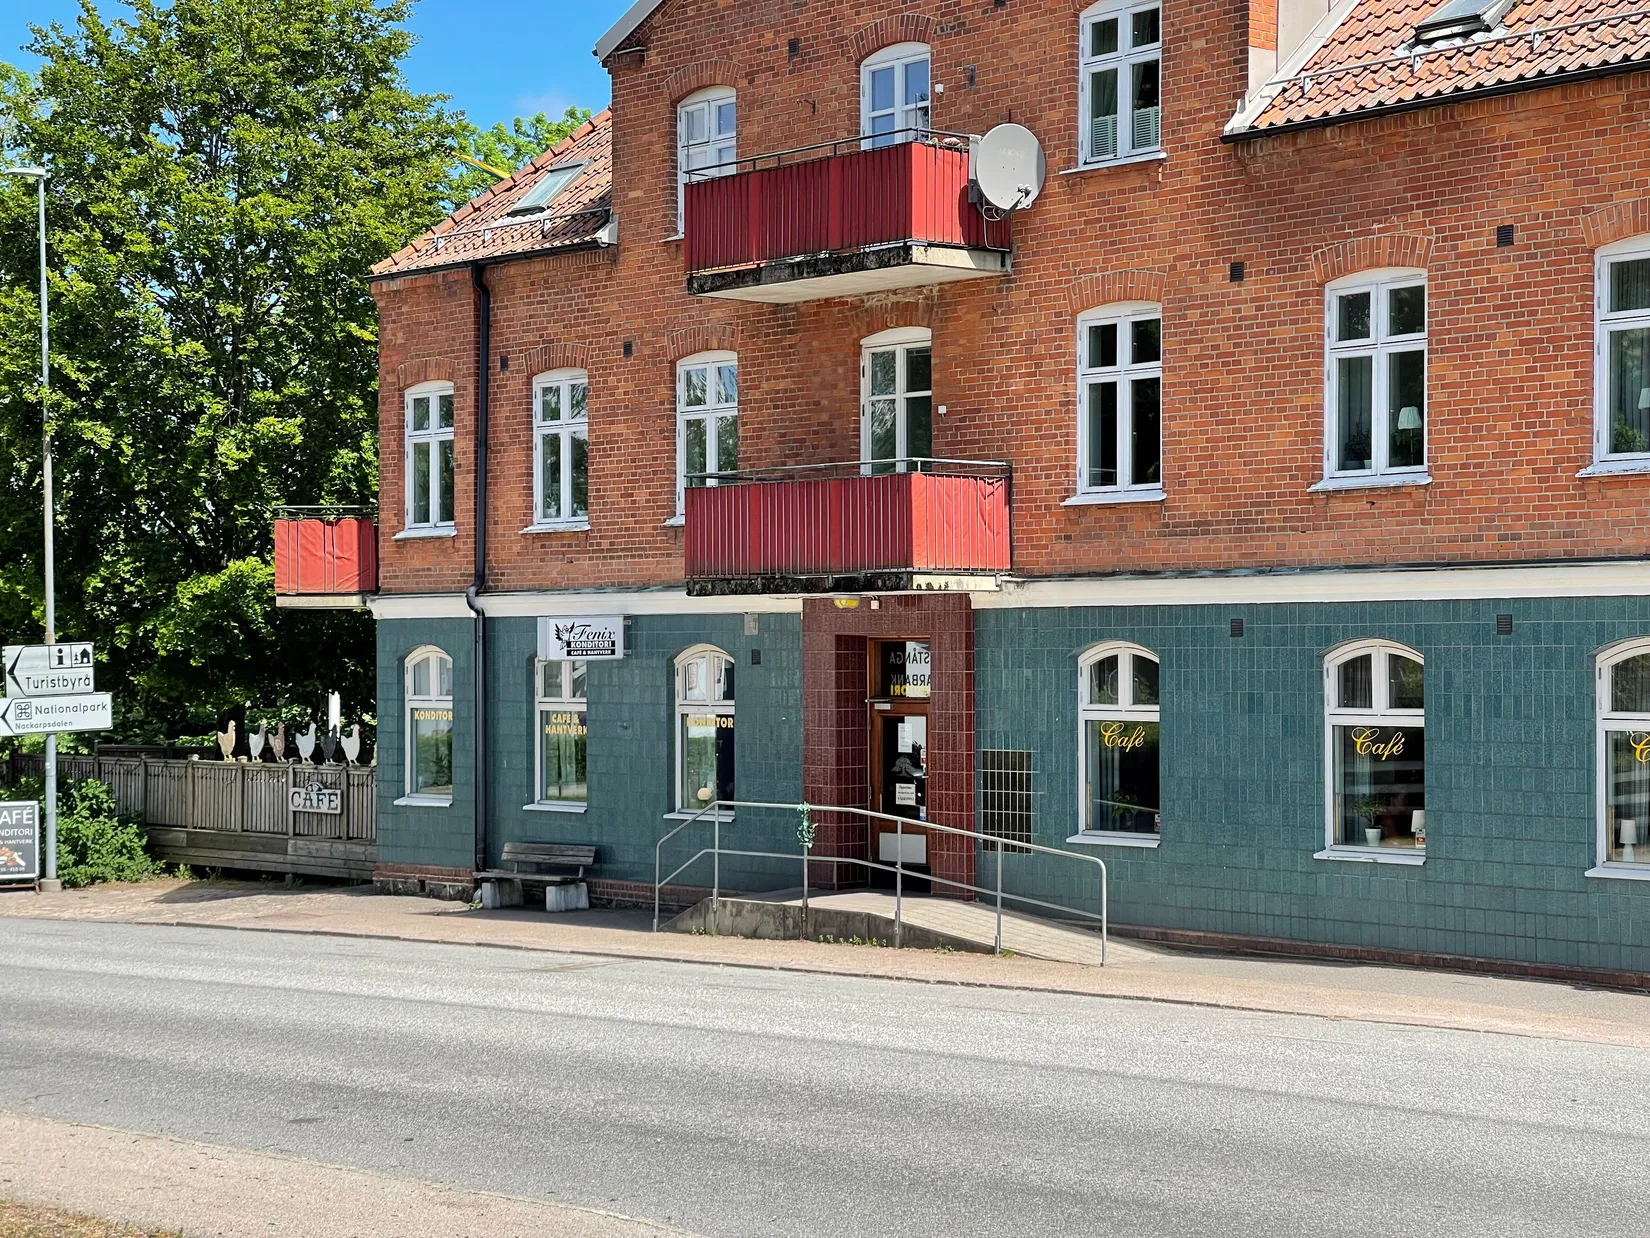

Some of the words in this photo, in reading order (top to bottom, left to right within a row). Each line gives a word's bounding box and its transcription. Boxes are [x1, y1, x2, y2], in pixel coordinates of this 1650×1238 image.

[573, 624, 615, 640] Fenix
[25, 674, 91, 690] Turistbyrå
[35, 702, 108, 715] Nationalpark
[15, 720, 73, 730] Nackarpsdalen
[552, 711, 571, 723] CAFÉ
[573, 713, 580, 724] &
[1101, 721, 1146, 753] Café
[1351, 726, 1405, 761] Café
